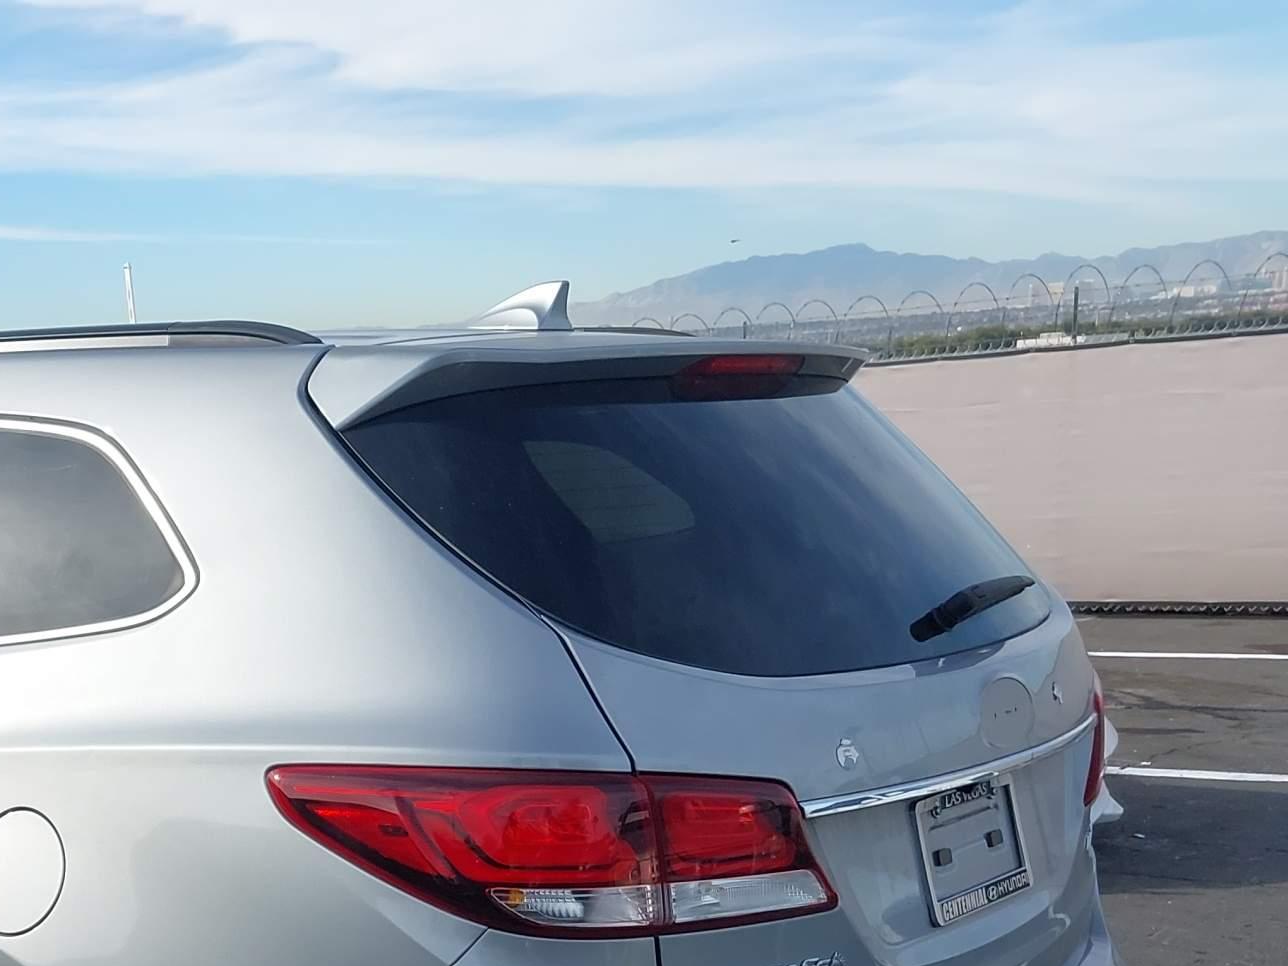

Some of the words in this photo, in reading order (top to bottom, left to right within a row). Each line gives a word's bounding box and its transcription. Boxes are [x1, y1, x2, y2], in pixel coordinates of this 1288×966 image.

[945, 791, 962, 808] LAS
[942, 887, 988, 921] CENTENNIAL
[997, 873, 1028, 896] HYUNDA
